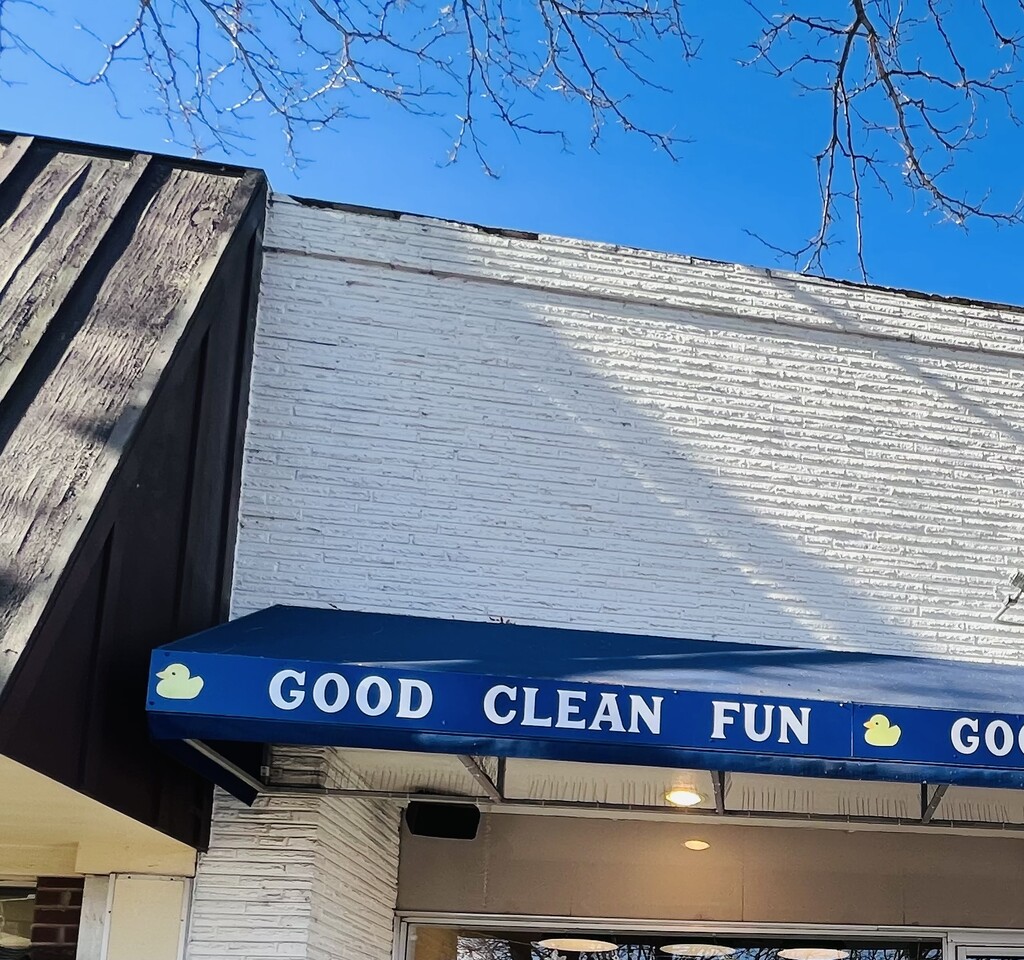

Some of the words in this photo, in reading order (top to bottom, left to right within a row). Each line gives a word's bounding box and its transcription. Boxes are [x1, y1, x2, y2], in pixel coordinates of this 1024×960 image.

[268, 668, 434, 719] GOOD
[483, 685, 664, 736] CLEAN
[710, 700, 812, 745] FUN
